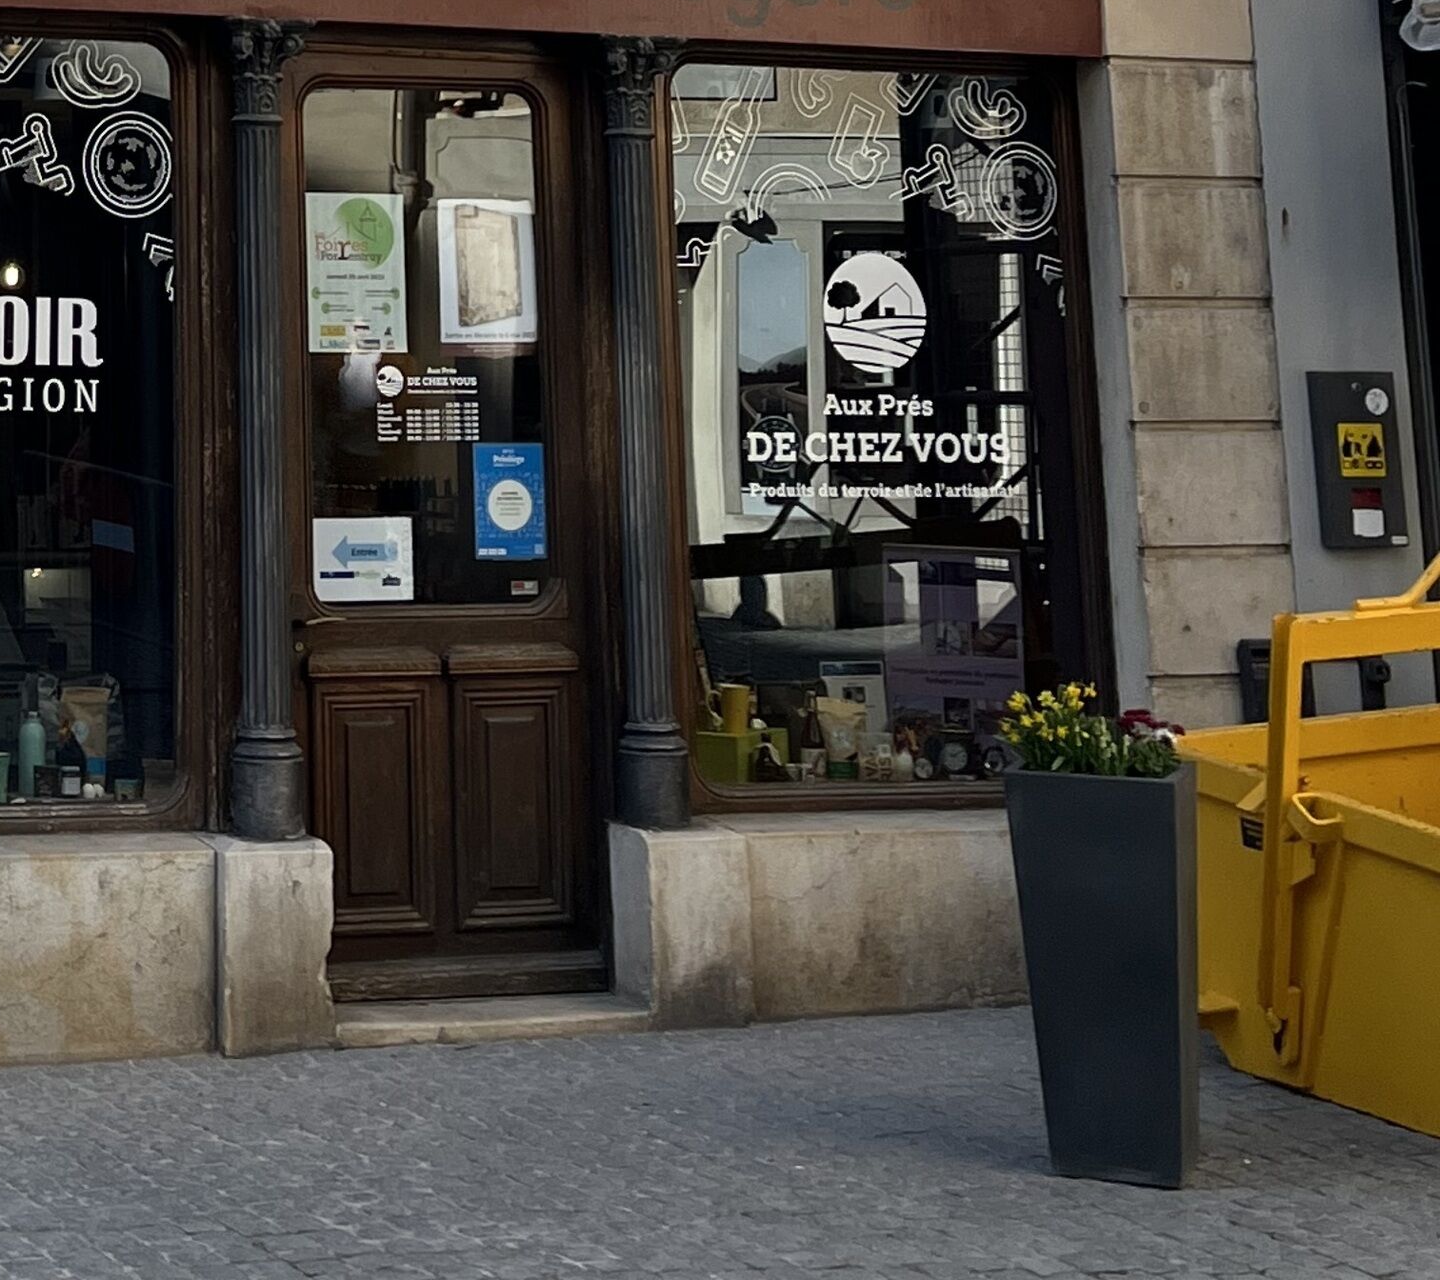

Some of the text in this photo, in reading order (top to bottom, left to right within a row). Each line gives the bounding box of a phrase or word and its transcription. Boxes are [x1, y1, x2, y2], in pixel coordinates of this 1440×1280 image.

[422, 376, 448, 386] CHEZ
[449, 376, 478, 387] VOUS
[822, 393, 935, 418] Aux Prés
[746, 431, 1012, 465] DE CHEZ VOUS
[749, 482, 815, 498] Produits
[818, 482, 839, 498] du
[842, 483, 893, 498] terroir
[914, 483, 933, 498] de
